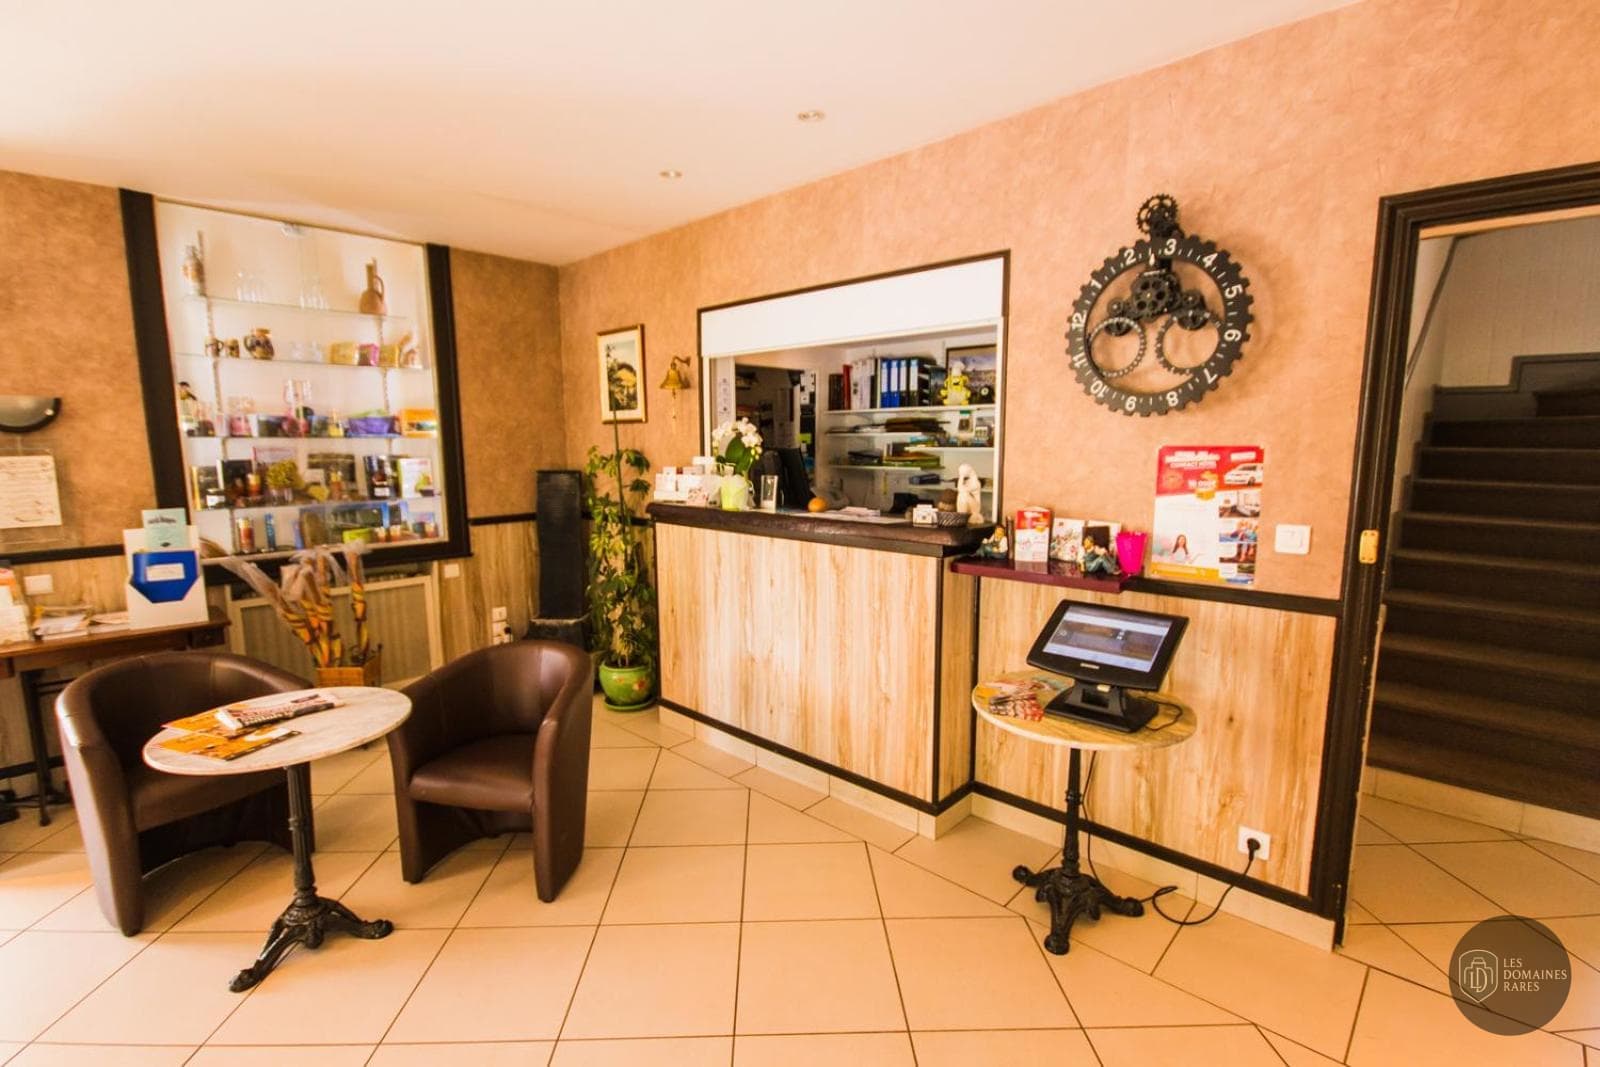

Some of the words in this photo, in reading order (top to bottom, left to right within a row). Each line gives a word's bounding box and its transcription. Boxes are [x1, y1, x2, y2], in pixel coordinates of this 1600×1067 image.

[1164, 239, 1177, 256] 3
[1123, 250, 1137, 265] 2
[1203, 252, 1218, 268] 4
[1091, 279, 1103, 290] 1
[1224, 284, 1242, 298] 5
[1071, 312, 1087, 330] 12
[1224, 329, 1242, 342] 6
[1203, 368, 1218, 384] 7
[1090, 381, 1110, 398] 10
[1125, 395, 1137, 411] 9
[1166, 391, 1179, 407] 8
